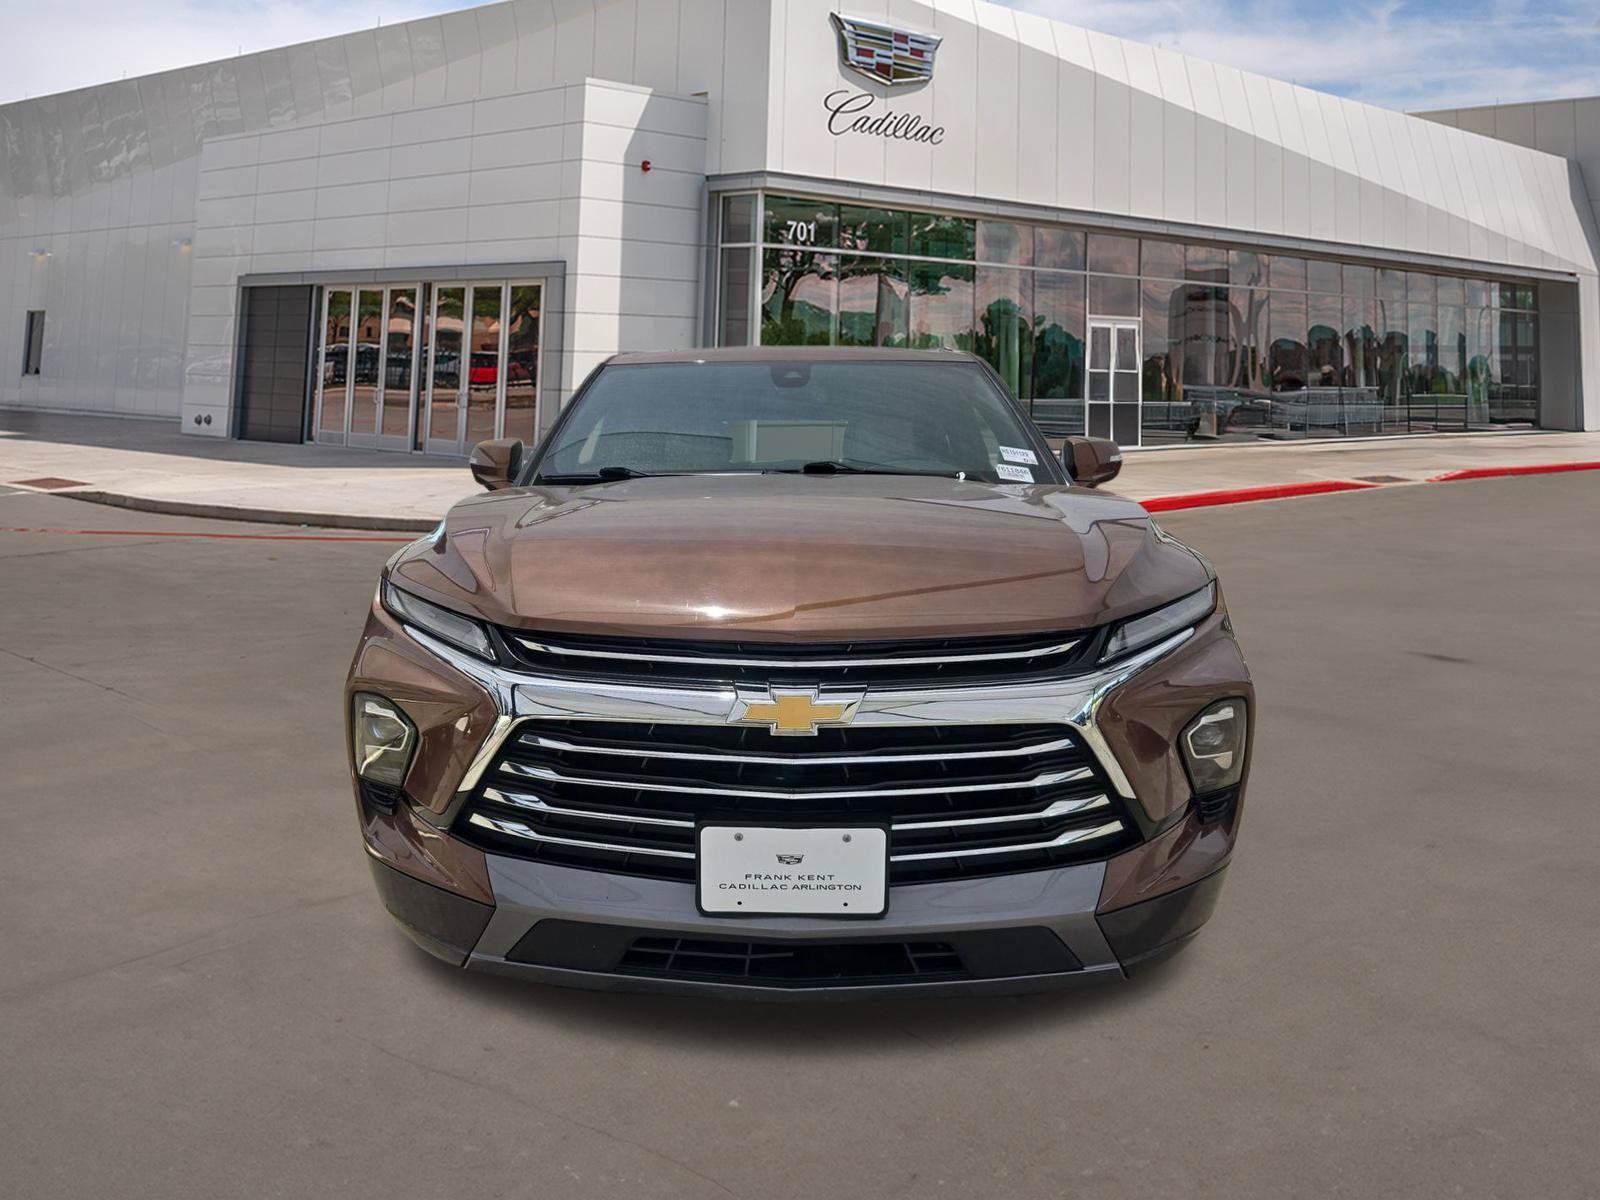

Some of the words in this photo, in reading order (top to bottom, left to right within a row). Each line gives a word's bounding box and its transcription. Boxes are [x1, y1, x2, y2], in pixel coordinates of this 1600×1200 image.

[824, 90, 945, 145] Cadillac
[786, 220, 816, 242] 701
[744, 873, 792, 881] FRANK
[797, 873, 836, 881] KENT
[718, 883, 788, 891] CADILLAC
[791, 883, 862, 891] ARLINGTON
